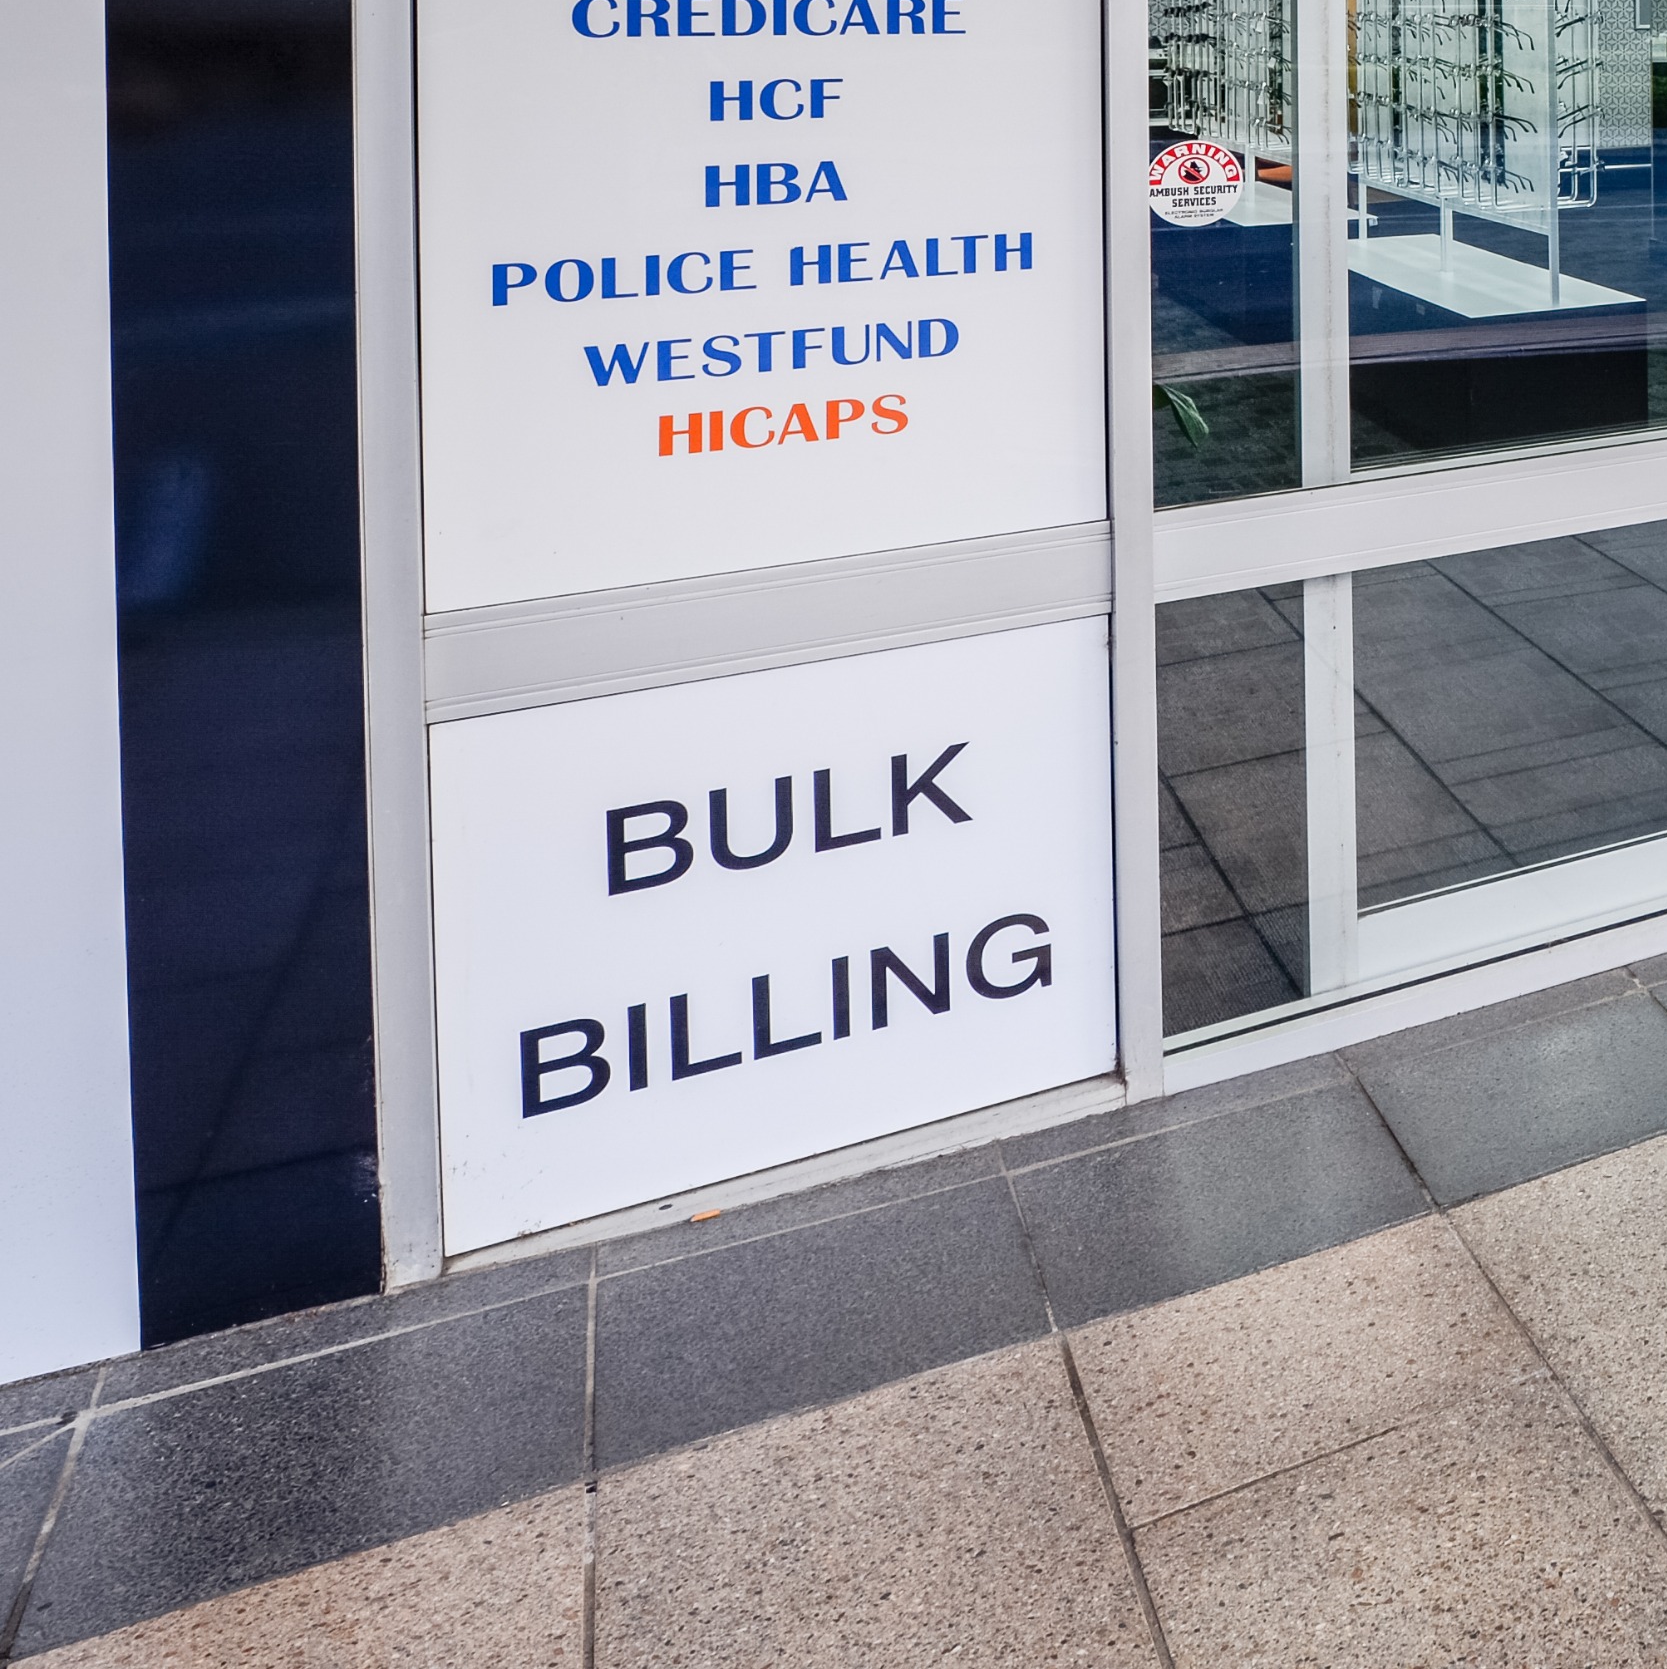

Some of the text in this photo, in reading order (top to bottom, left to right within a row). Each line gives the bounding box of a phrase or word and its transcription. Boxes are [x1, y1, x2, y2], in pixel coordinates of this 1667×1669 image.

[709, 78, 843, 122] HCF
[705, 161, 848, 207] HBA
[1150, 143, 1238, 181] WARNING
[1149, 184, 1238, 198] AMBUSH SECURITY
[1172, 197, 1217, 208] SERVICES
[492, 232, 1033, 307] POLICE HEALTH
[584, 318, 959, 387] WESTFUND
[658, 394, 909, 457] HICAPS
[605, 741, 974, 897] BULK
[519, 913, 1053, 1119] BILLING
